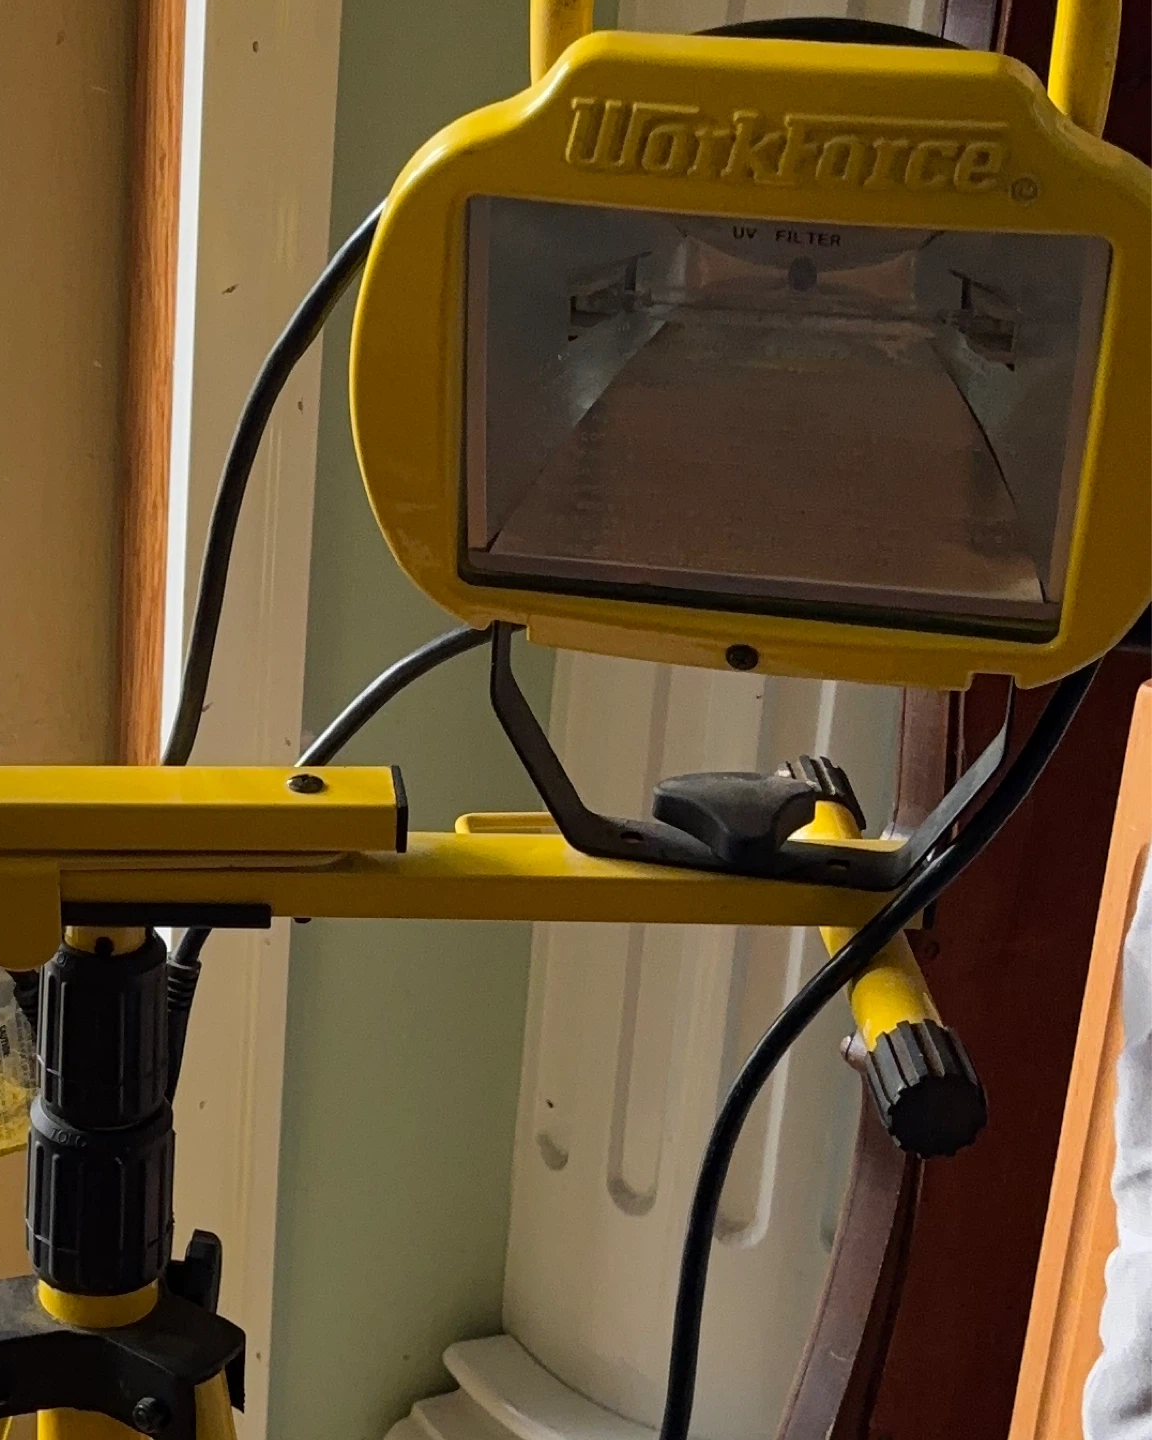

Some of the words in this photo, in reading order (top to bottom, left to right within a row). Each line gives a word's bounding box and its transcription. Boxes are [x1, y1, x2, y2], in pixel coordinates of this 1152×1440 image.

[564, 96, 1010, 193] WorkForce
[732, 226, 757, 240] UV
[775, 229, 842, 247] FILTER
